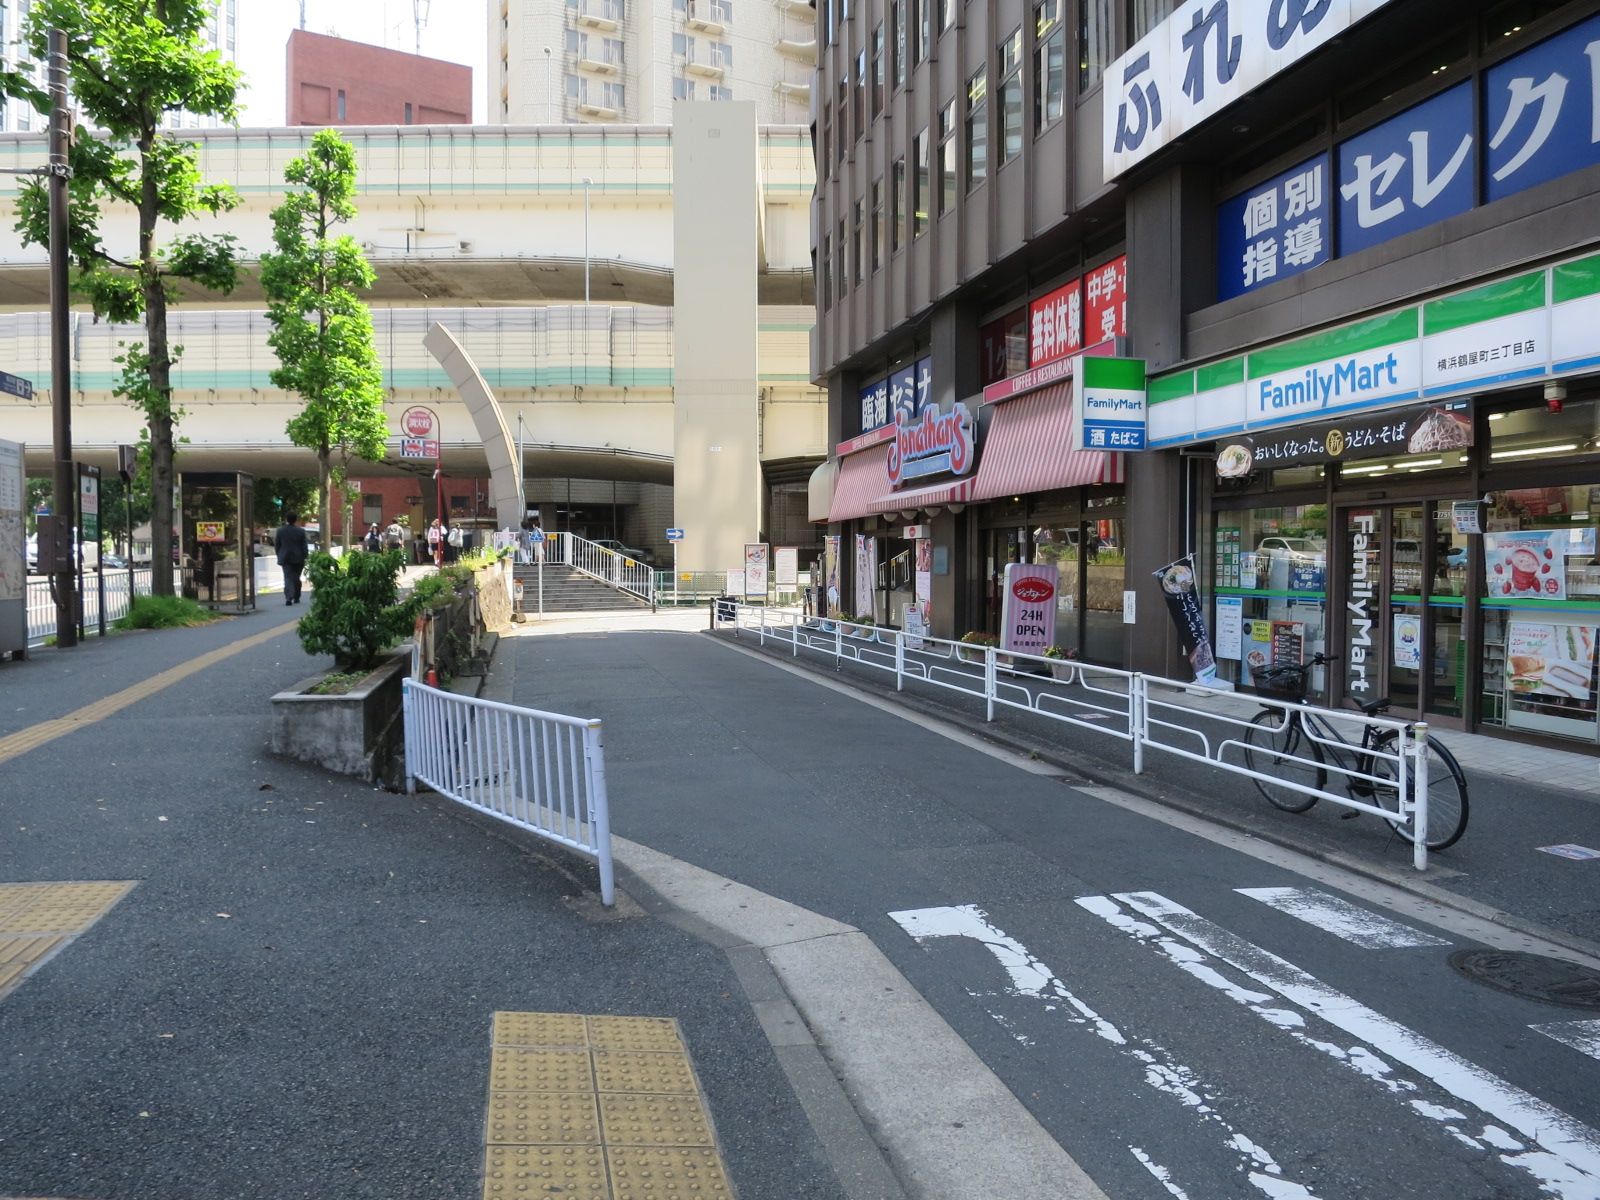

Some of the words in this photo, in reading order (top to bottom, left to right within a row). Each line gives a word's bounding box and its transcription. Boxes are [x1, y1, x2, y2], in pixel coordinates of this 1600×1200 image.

[1243, 164, 1322, 240] 個別
[1243, 217, 1322, 287] 指導
[1032, 289, 1080, 363] 無料体験
[1437, 339, 1535, 372] 横浜鶴屋町三丁目店
[1012, 372, 1031, 392] COFFEE
[1038, 357, 1073, 383] RESTAURAN
[1260, 352, 1398, 411] FamilyMart
[1087, 397, 1142, 411] FamilyMart
[1090, 429, 1106, 446] 酒
[1110, 431, 1140, 445] たばこ
[1021, 609, 1043, 621] 24H
[1347, 515, 1374, 692] FamilyMart
[1016, 624, 1046, 636] OPEN
